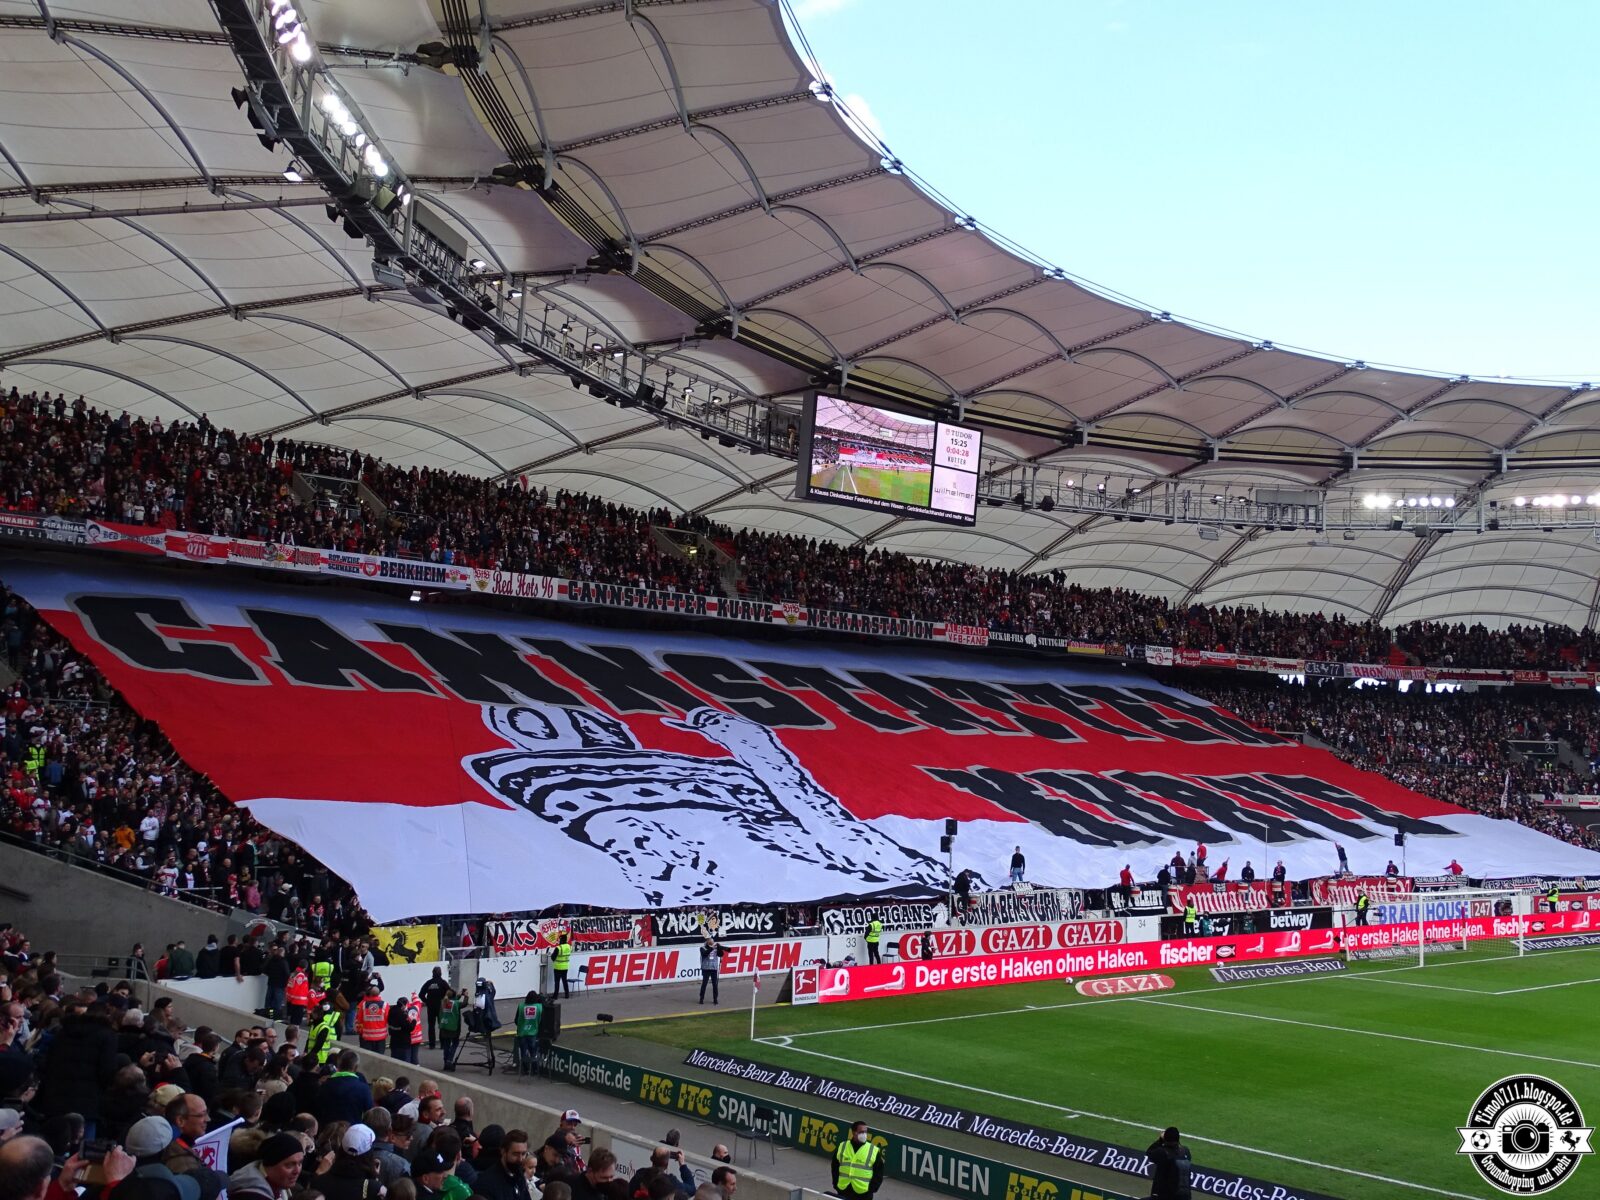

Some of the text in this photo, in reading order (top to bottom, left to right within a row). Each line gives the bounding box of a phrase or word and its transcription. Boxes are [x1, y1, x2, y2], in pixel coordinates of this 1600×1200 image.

[951, 430, 973, 440] TUDOR
[951, 438, 968, 448] 15:25
[946, 446, 970, 457] 0:04:28
[42, 520, 86, 533] PIRANHAS
[187, 543, 207, 556] 0711
[380, 561, 447, 583] BERKHEIM
[492, 570, 554, 598] Red Hots 96
[568, 580, 773, 622] CANNSTATTER KURVE
[807, 608, 933, 640] NECKARSTADION
[946, 623, 988, 636] ALBSTADT
[947, 634, 987, 646] VFB-FANS
[988, 630, 1024, 643] NECKAR-FILS
[1038, 638, 1068, 648] STUTTGART
[911, 764, 1470, 848] KURVE
[571, 914, 632, 933] SUPPORTERS
[656, 910, 774, 935] YARD BWOYS
[1138, 919, 1146, 928] 34
[1269, 911, 1313, 930] betway
[494, 919, 539, 947] DKS
[846, 937, 857, 948] 33
[1361, 928, 1390, 946] erste
[1391, 926, 1423, 943] Hake
[1425, 924, 1453, 939] ohne
[1159, 941, 1213, 965] fischer
[502, 960, 517, 973] 32
[915, 949, 1148, 988] Der erste Haken ohne Haken.
[1221, 958, 1346, 982] Mercedes-Benz
[639, 1072, 674, 1106] ITC
[677, 1082, 713, 1116] ITC
[686, 1048, 776, 1085] Mercedes-Benz
[774, 1071, 812, 1093] Bank
[814, 1078, 921, 1119] Mercedes-Benz
[920, 1104, 965, 1130] Bank
[966, 1115, 1099, 1163] Mercedes-Benz
[1098, 1147, 1155, 1177] Bank
[798, 1115, 840, 1154] ITC
[801, 1125, 838, 1144] LOGISTIC
[901, 1143, 991, 1196] ITALIEN
